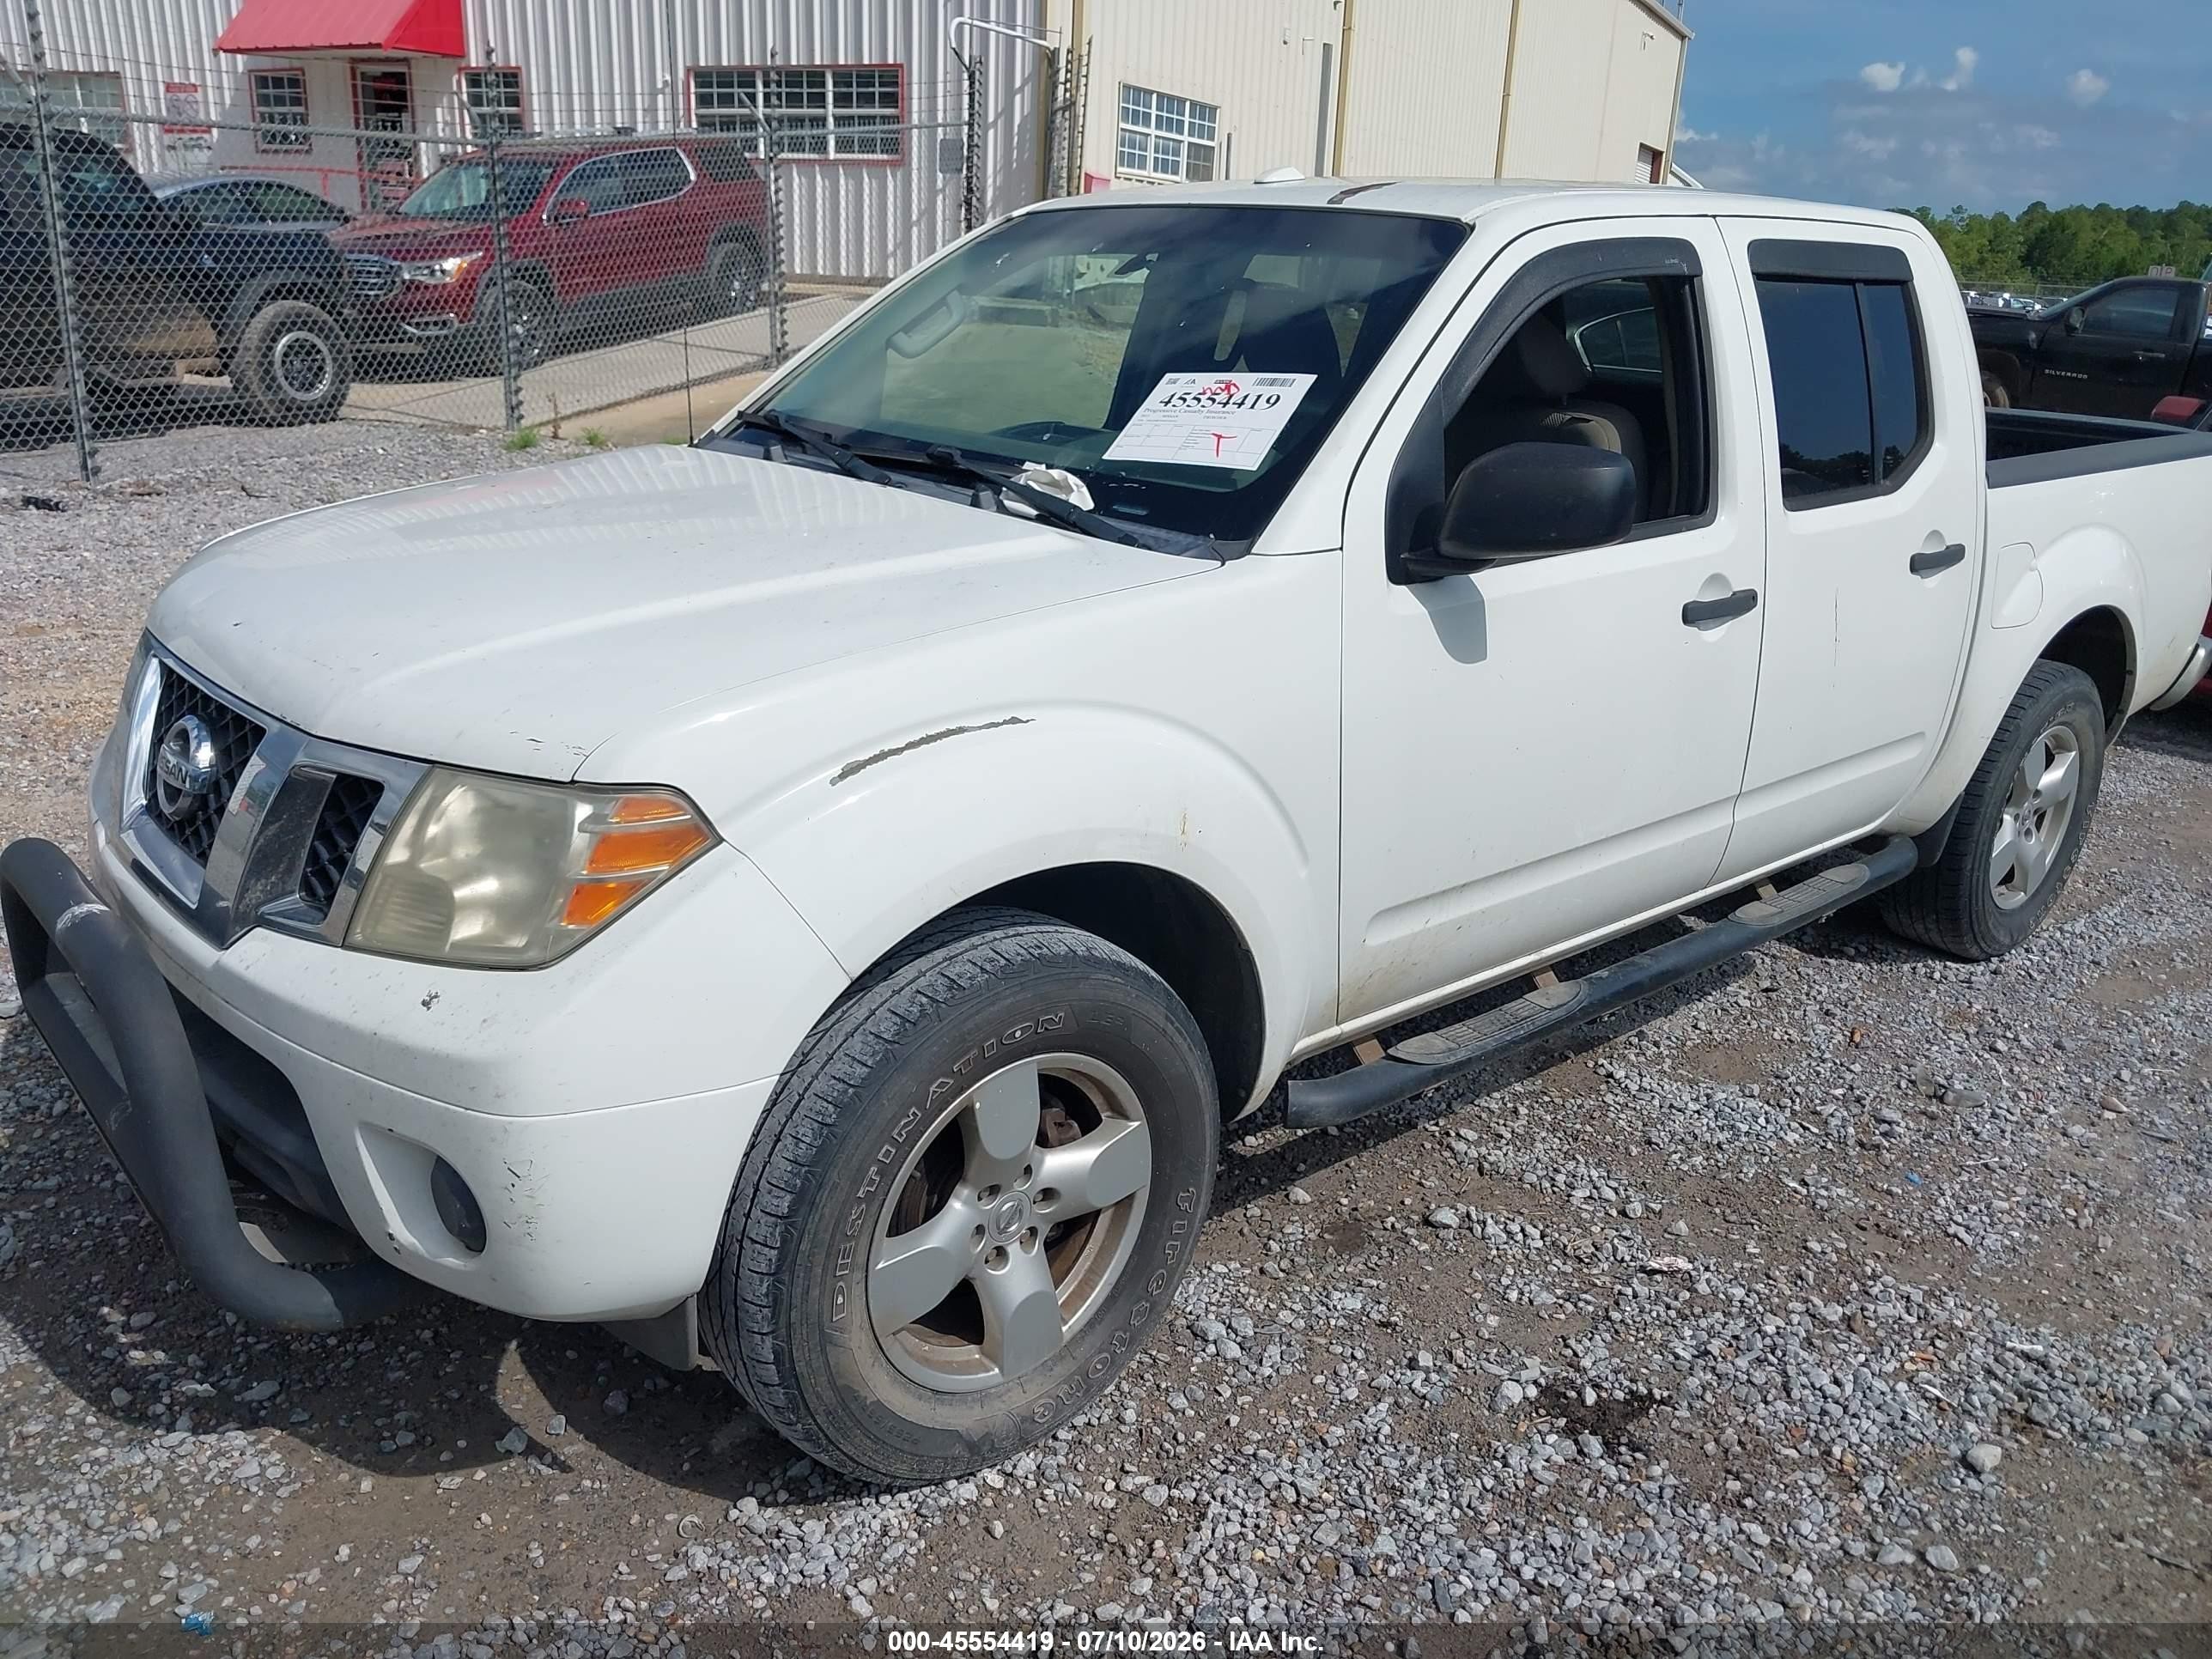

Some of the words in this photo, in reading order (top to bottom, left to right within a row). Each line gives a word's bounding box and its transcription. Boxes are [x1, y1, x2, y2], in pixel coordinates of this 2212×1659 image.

[2045, 368, 2088, 380] SILVERADO
[1158, 392, 1281, 410] 45554419
[832, 1012, 1066, 1322] DESTINATION
